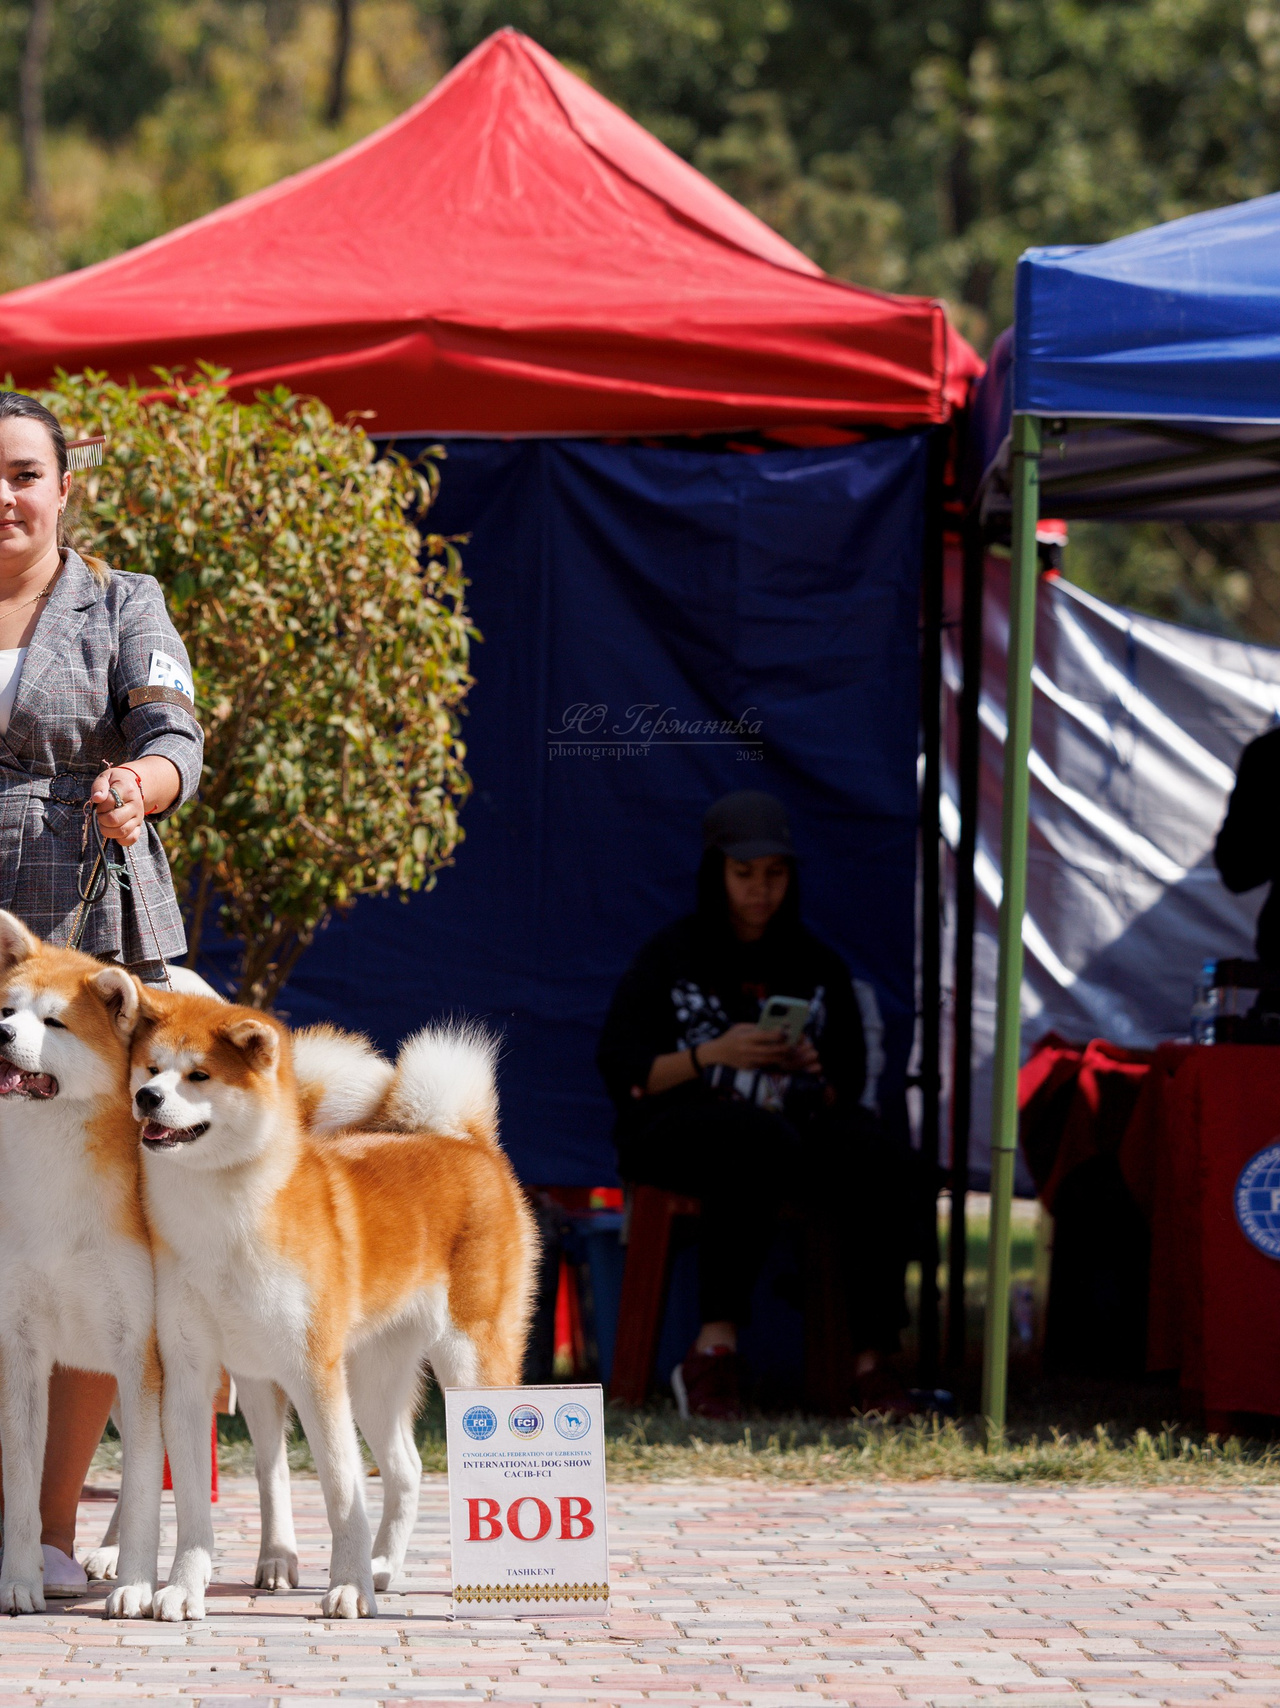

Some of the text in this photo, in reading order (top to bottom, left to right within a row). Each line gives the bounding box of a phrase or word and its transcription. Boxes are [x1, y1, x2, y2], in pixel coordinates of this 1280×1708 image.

[473, 1418, 487, 1427] FCI
[517, 1418, 535, 1427] FCI
[463, 1459, 592, 1469] INTERNATIONAL DOG SHOW
[504, 1470, 552, 1478] CACIB-FCI
[463, 1496, 595, 1542] BOB
[506, 1568, 556, 1577] TASHKENT
